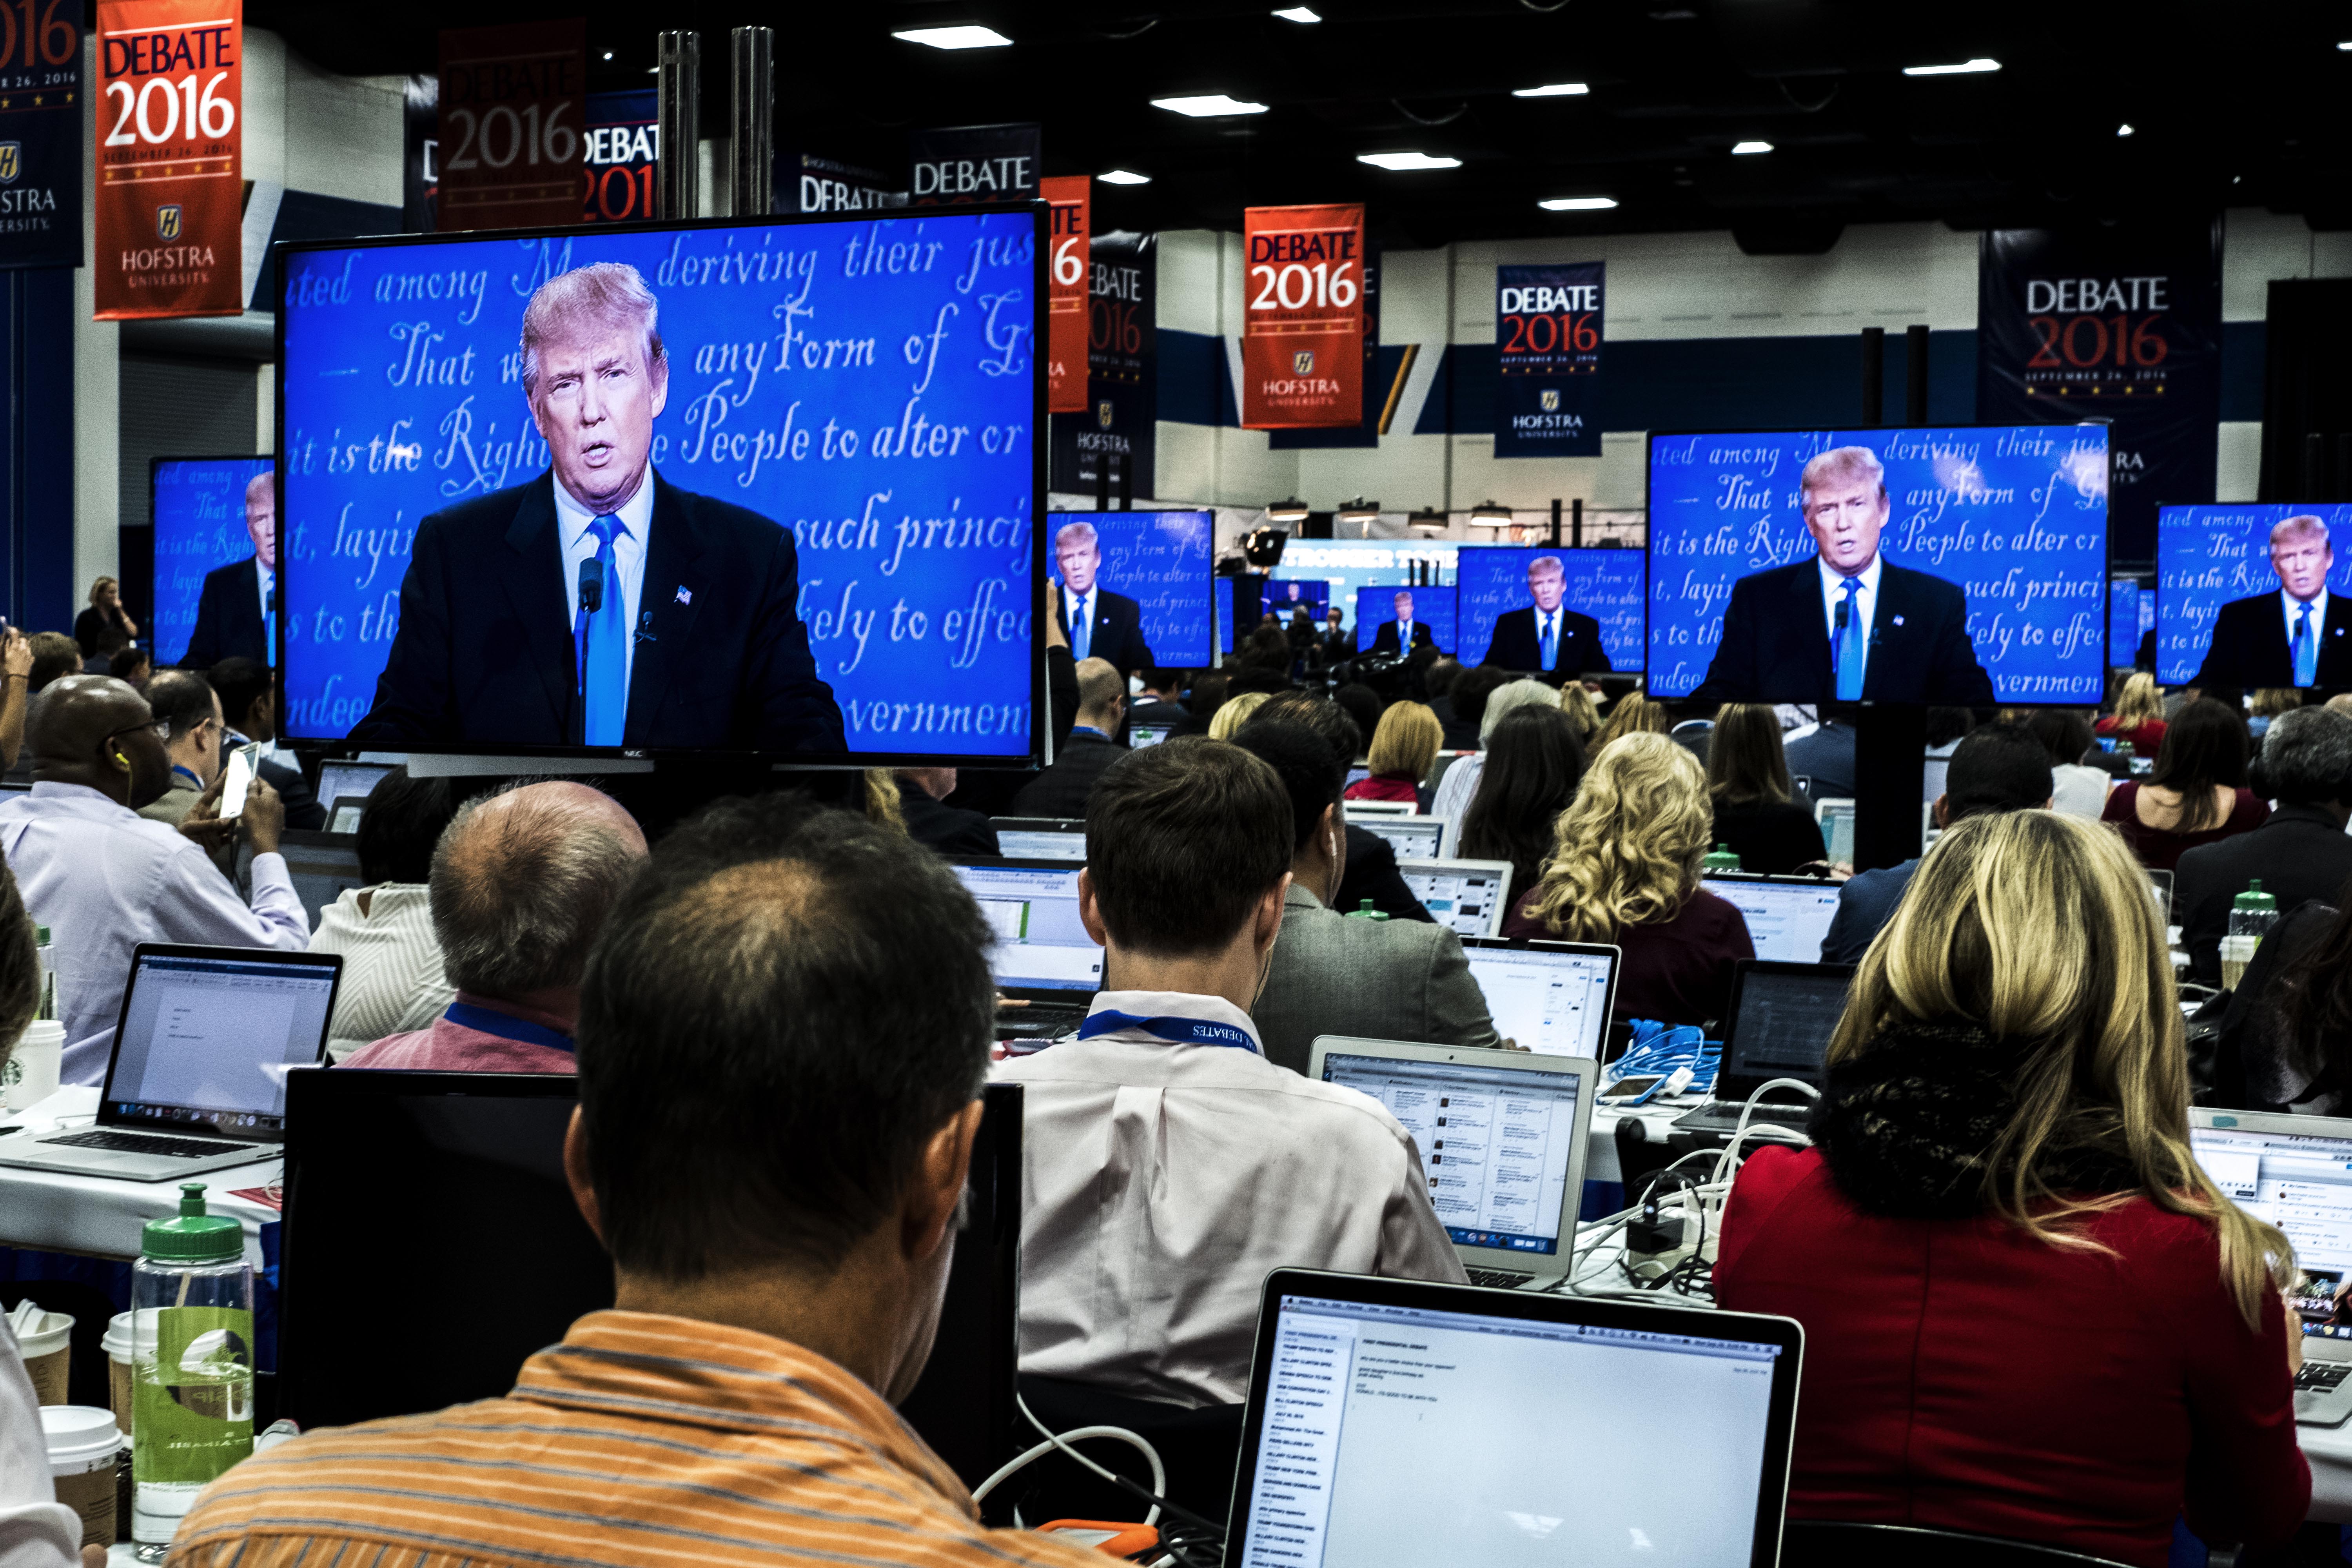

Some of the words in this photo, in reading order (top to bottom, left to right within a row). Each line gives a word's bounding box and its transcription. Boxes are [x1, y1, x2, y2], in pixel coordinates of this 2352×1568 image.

[104, 27, 234, 78] DEBATE
[44, 72, 76, 85] 2016
[446, 59, 576, 105] DEBATE
[105, 71, 235, 147] 2016
[445, 101, 577, 170] 2016
[583, 124, 660, 165] EBAT
[913, 156, 1033, 195] DEBATE
[1, 189, 56, 214] STRA
[0, 218, 50, 233] ERSITY
[122, 245, 215, 271] HOFSTRA
[1250, 230, 1357, 263] DEBATE
[128, 272, 210, 289] UNIVERSITY
[374, 267, 488, 325] among
[657, 232, 817, 302] deriving
[844, 219, 942, 278] their
[1089, 262, 1143, 302] EBATE
[1250, 261, 1357, 309] 2016
[1501, 285, 1599, 314] DEBATE
[2026, 276, 2171, 314] DEBATE
[1089, 298, 1142, 354] 016
[1503, 313, 1598, 352] 2016
[2026, 313, 2169, 368] 2016
[387, 321, 475, 387] That
[695, 340, 768, 407] any
[773, 296, 876, 373] Form
[904, 303, 959, 394] of
[1263, 379, 1339, 395] HOFSTRA
[2025, 372, 2099, 381] SEPTEMBER
[2136, 370, 2167, 380] 2016
[1268, 396, 1335, 407] UNIVERSITY
[287, 428, 316, 475] it
[328, 427, 361, 474] is
[368, 416, 422, 473] the
[433, 395, 552, 497] Righ
[680, 378, 810, 487] People
[822, 417, 860, 461] to
[871, 396, 969, 459] alter
[981, 424, 1023, 455] or
[1512, 414, 1583, 429] HOFSTRA
[1518, 430, 1579, 439] UNIVERSITY
[1077, 430, 1131, 453] HOFSTRA
[1708, 446, 1780, 478] among
[1884, 431, 1980, 470] deriving
[1996, 429, 2056, 457] their
[1716, 474, 1772, 510] That
[1906, 488, 1951, 523] any
[1952, 466, 2014, 507] Form
[2031, 470, 2063, 519] of
[795, 489, 892, 550] such
[1654, 530, 1671, 556] it
[1678, 529, 1697, 555] is
[1703, 523, 1739, 556] the
[1744, 513, 1819, 568] Righ
[1897, 507, 1976, 566] People
[1982, 529, 2005, 552] to
[2011, 517, 2069, 552] alter
[2075, 532, 2100, 551] or
[1282, 548, 1394, 568] TRONGER
[2207, 532, 2247, 559] That
[1964, 565, 2025, 599] such
[2197, 566, 2223, 589] the
[2228, 559, 2282, 597] Righ
[315, 603, 345, 643] to
[890, 597, 929, 643] to
[1668, 624, 1687, 646] to
[2020, 621, 2044, 646] to
[1996, 672, 2099, 694] vernmen
[846, 698, 1031, 735] vernmen
[1193, 1025, 1243, 1044] DEBATES
